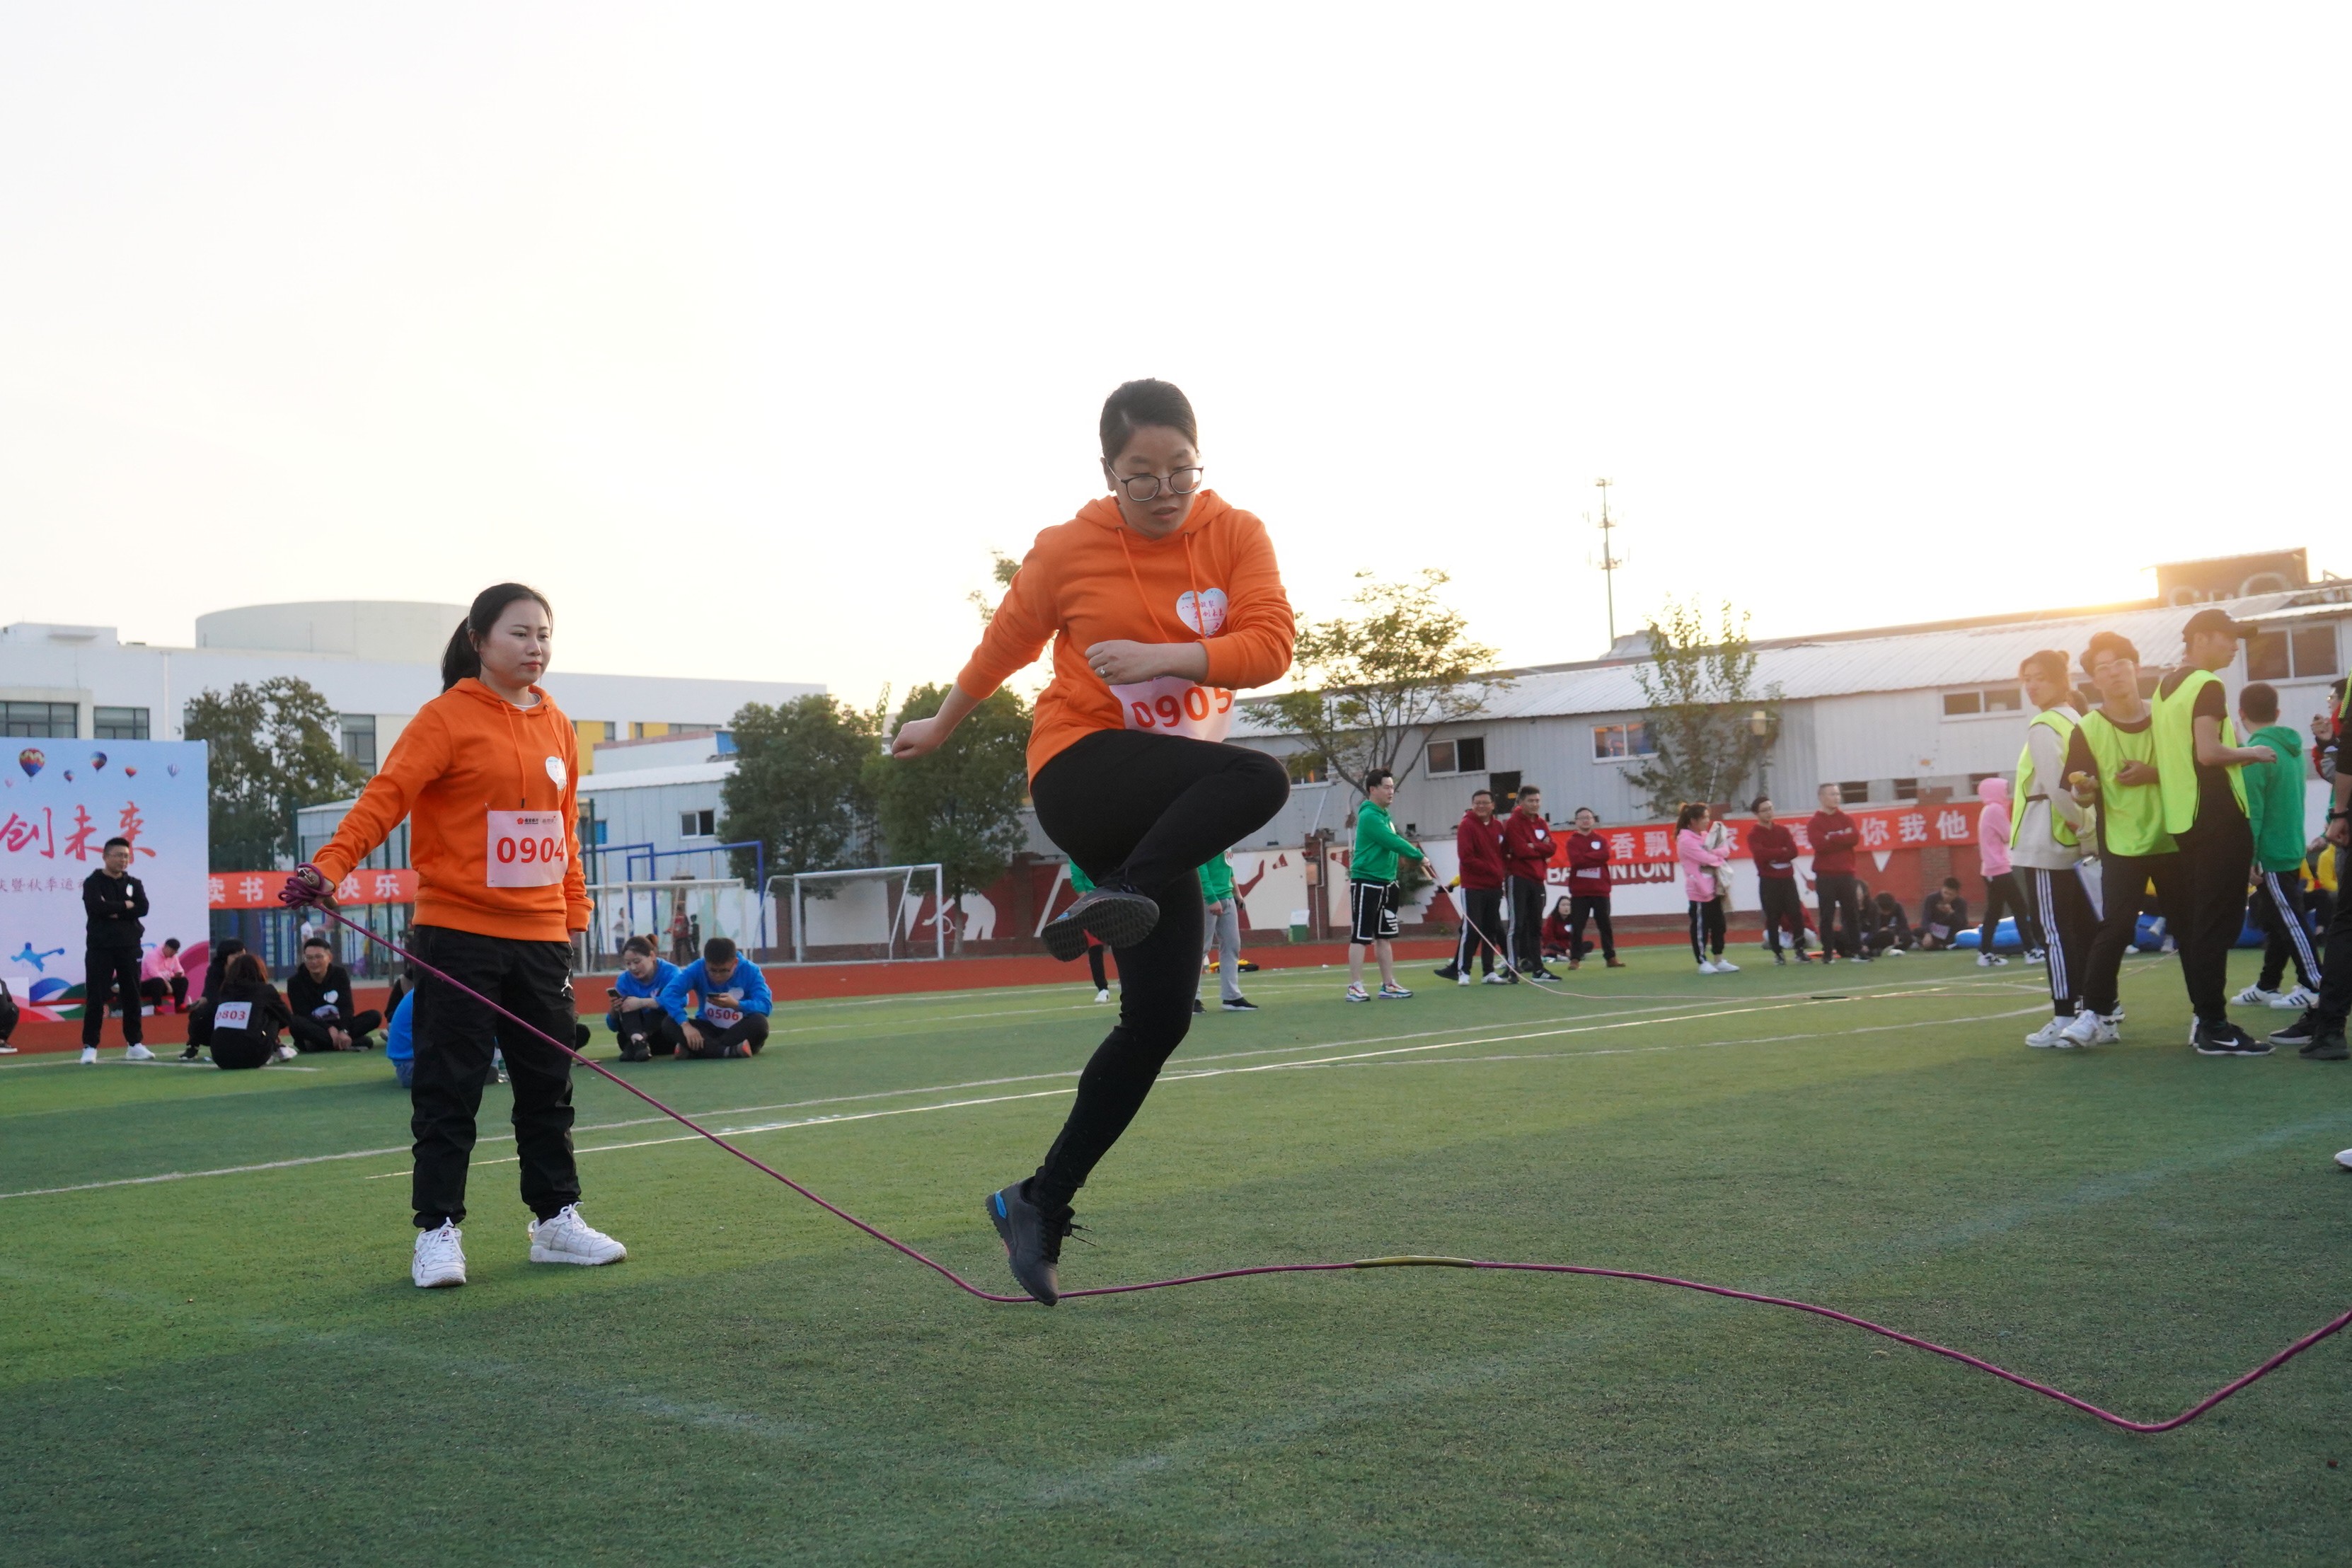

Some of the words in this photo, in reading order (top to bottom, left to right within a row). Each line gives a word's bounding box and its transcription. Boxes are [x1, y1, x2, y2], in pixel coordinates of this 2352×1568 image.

[1131, 686, 1233, 728] 0905
[497, 837, 565, 863] 0904
[215, 1010, 246, 1020] 0803
[708, 1008, 739, 1020] 0506
